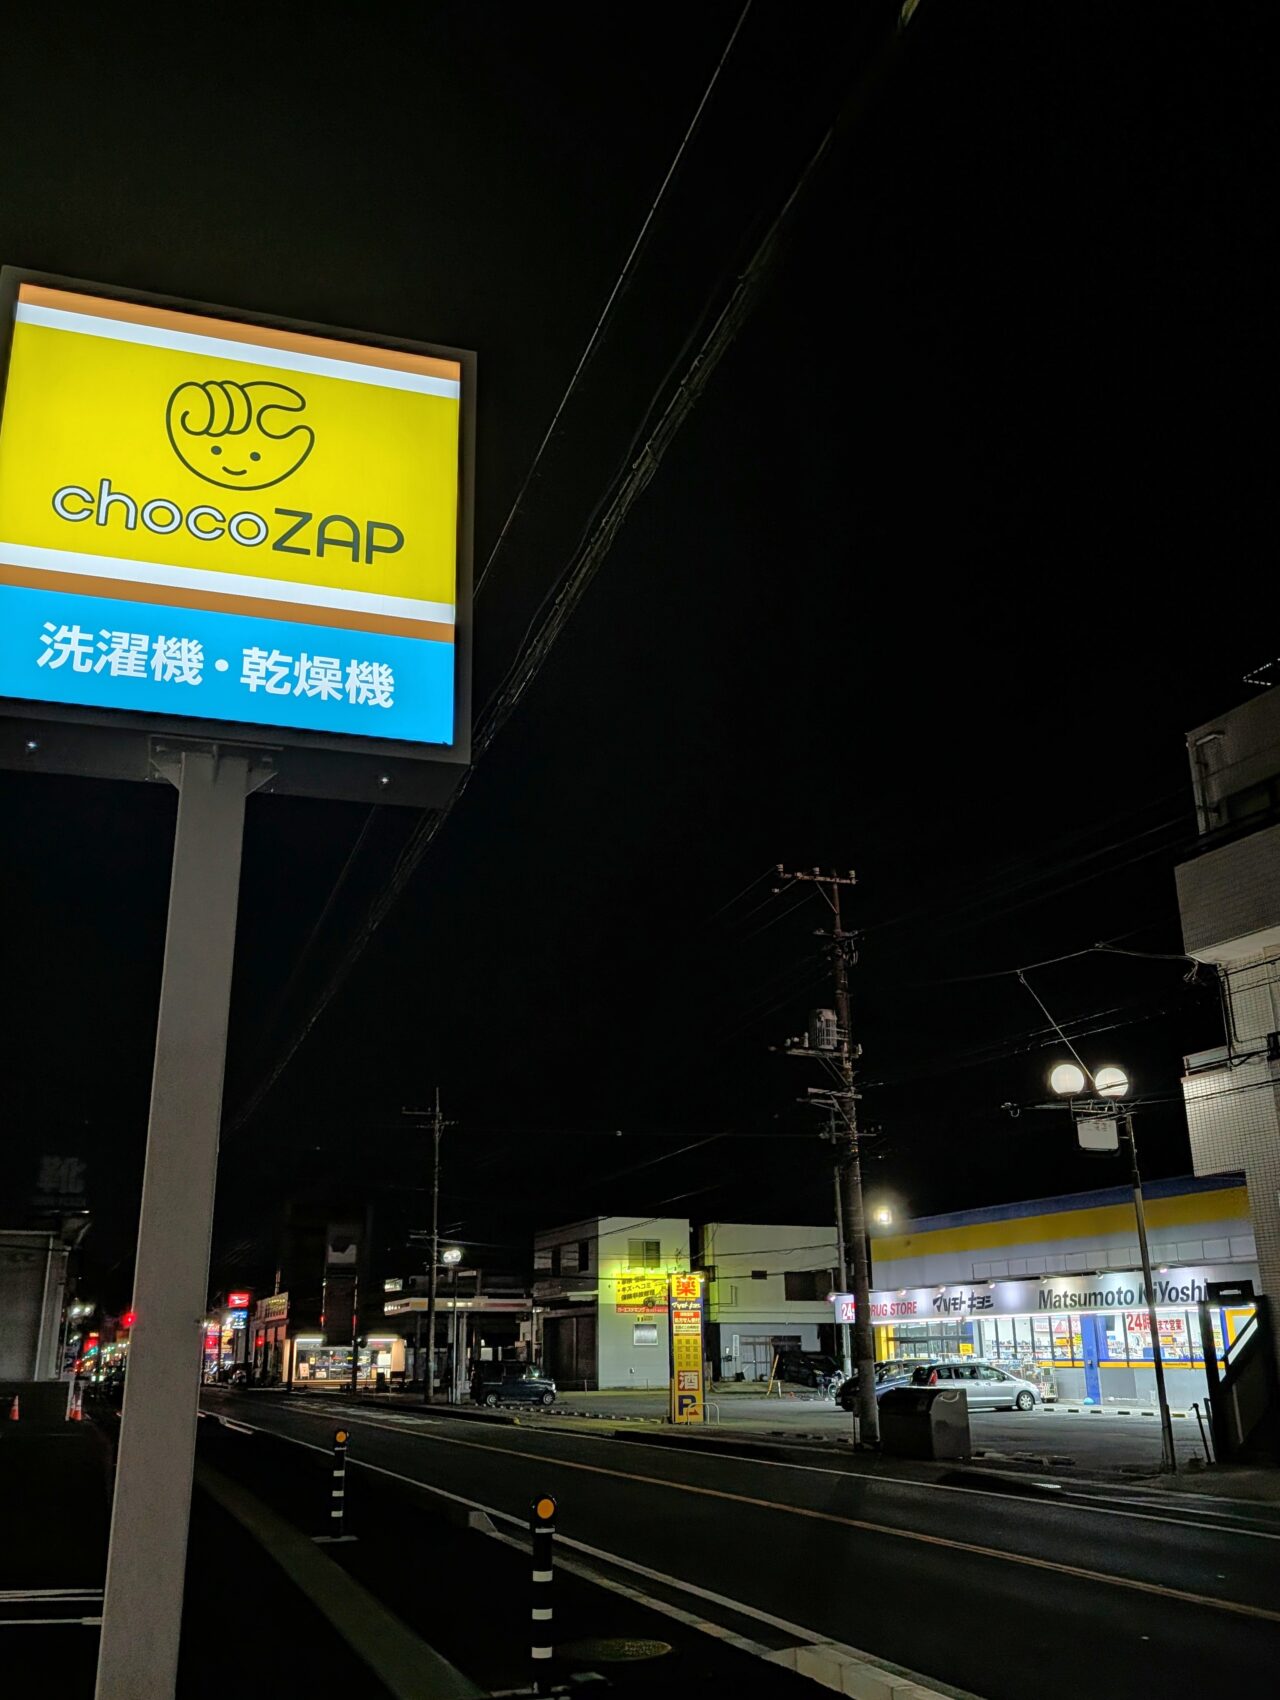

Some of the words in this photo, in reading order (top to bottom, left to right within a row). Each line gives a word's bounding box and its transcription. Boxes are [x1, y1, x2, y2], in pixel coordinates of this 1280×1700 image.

[52, 478, 405, 565] chocoZAP
[36, 621, 394, 709] 洗濯機・乾燥機
[675, 1275, 697, 1296] 薬
[869, 1302, 888, 1317] RUG
[889, 1301, 918, 1316] STORE
[1038, 1286, 1135, 1310] Matsumoto
[678, 1371, 698, 1390] 酒
[678, 1394, 697, 1416] P
